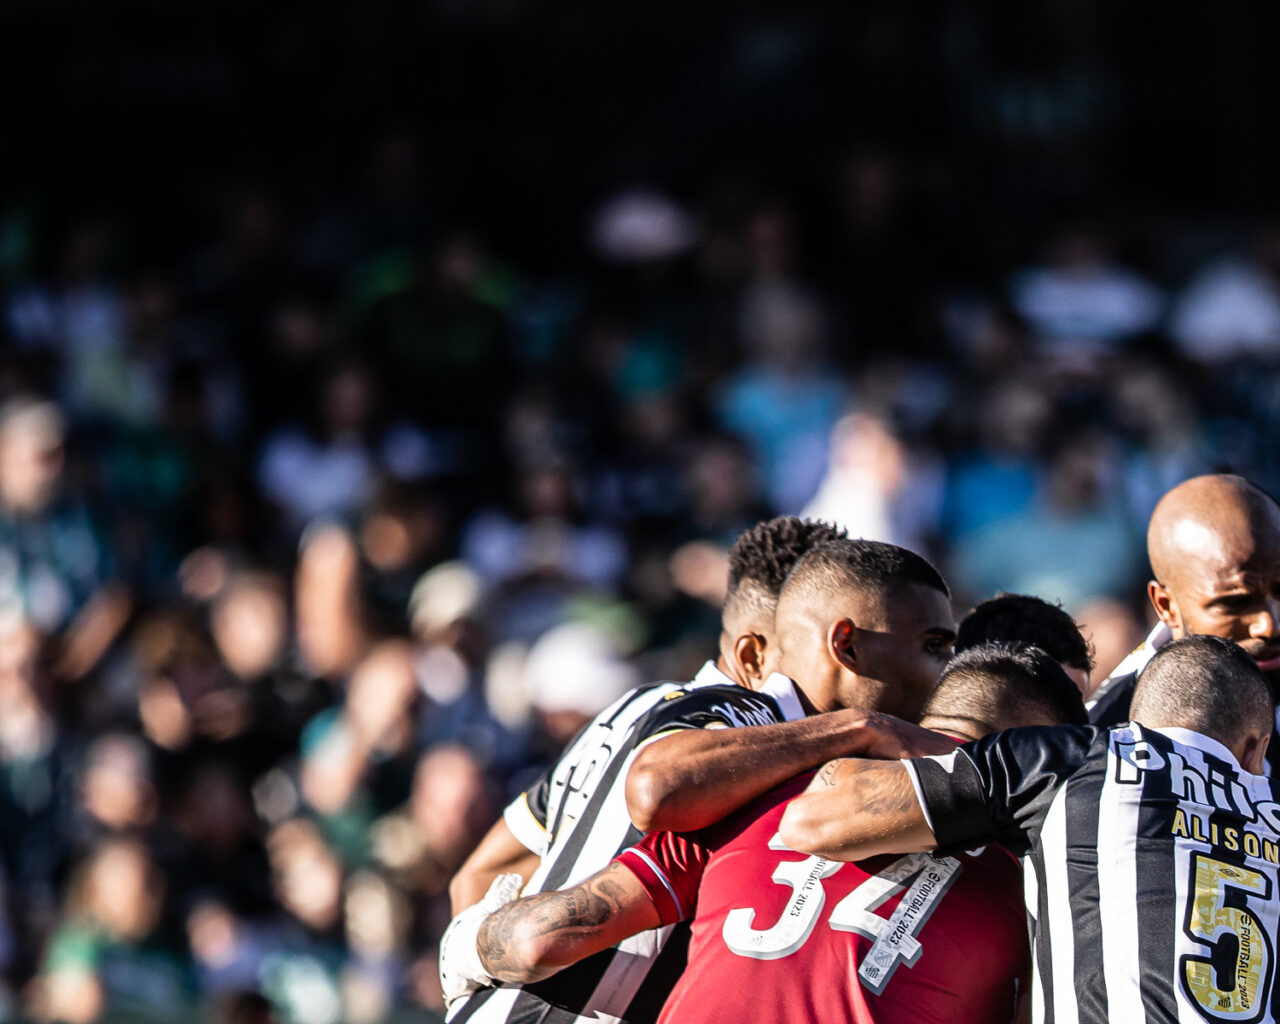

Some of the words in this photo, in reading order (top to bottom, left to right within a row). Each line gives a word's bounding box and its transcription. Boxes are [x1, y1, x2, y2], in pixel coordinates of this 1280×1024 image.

[1171, 808, 1280, 864] ALISON
[722, 832, 963, 996] 34
[889, 919, 909, 946] 2023
[1182, 852, 1271, 1017] 5
[1238, 983, 1250, 1010] 2023
